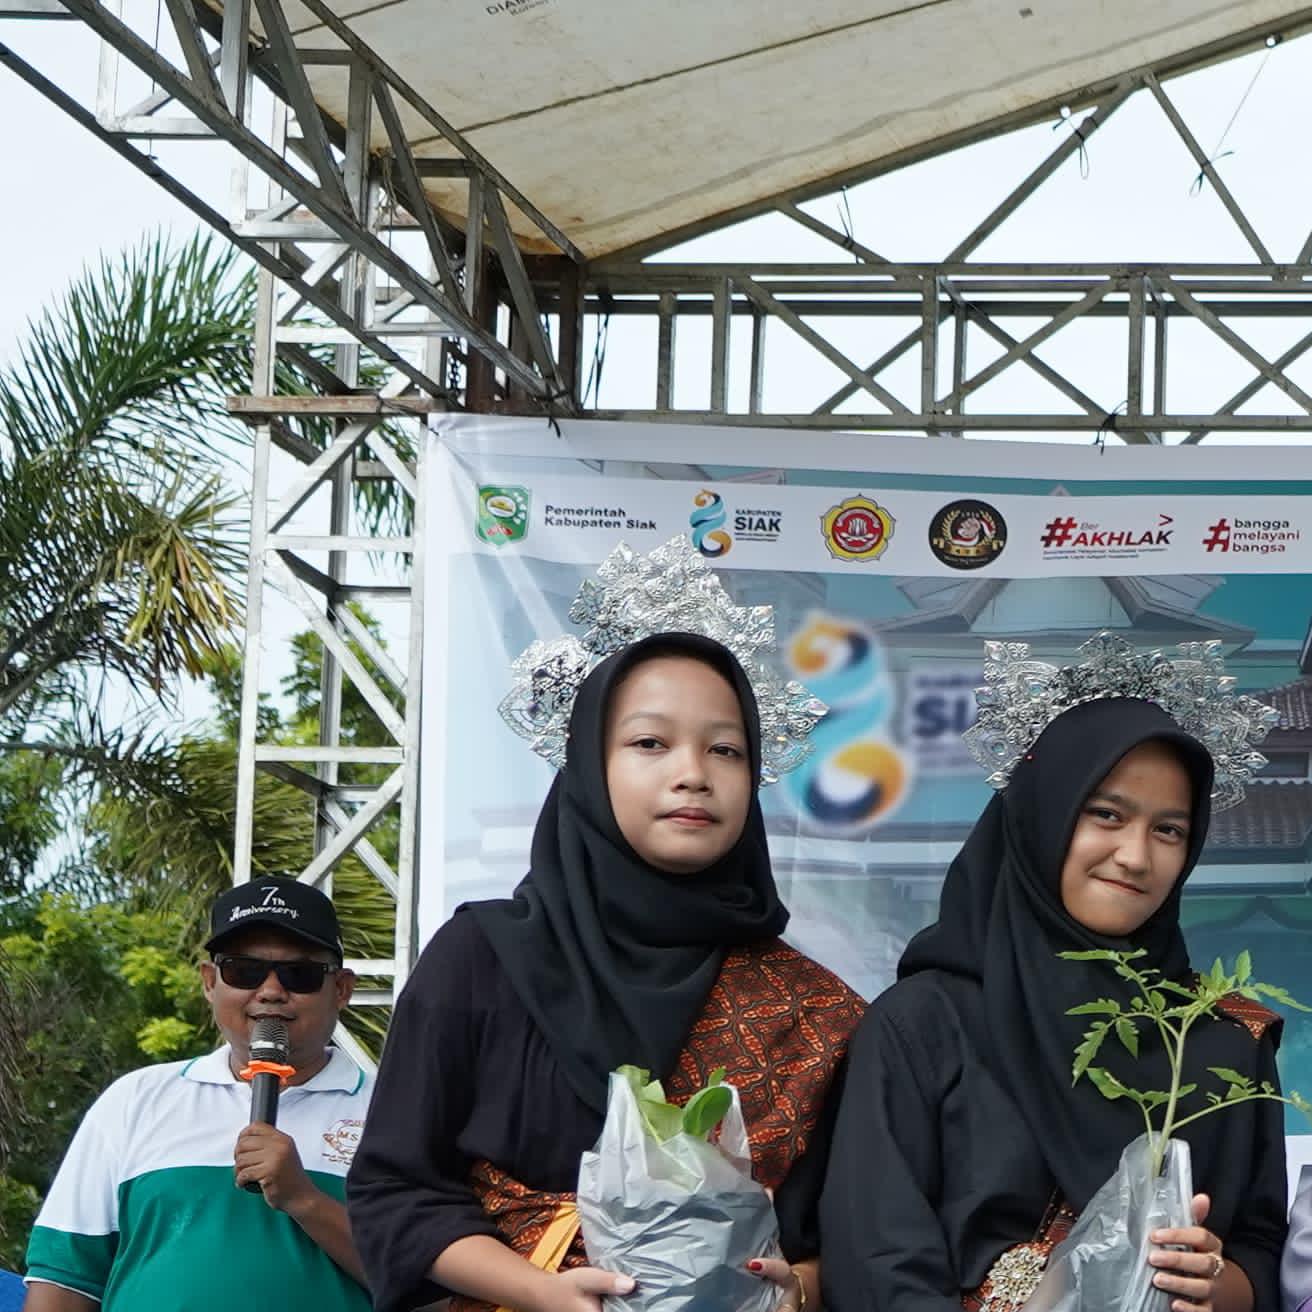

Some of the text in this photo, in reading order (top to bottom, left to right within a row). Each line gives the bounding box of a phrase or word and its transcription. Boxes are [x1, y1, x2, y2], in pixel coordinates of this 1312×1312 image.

[544, 505, 626, 518] Pemerintah
[544, 517, 657, 530] Kabupaten Siak
[735, 516, 782, 532] SIAK
[1234, 518, 1290, 530] bangga
[1233, 530, 1300, 542] melayani
[1232, 541, 1286, 555] bangsa
